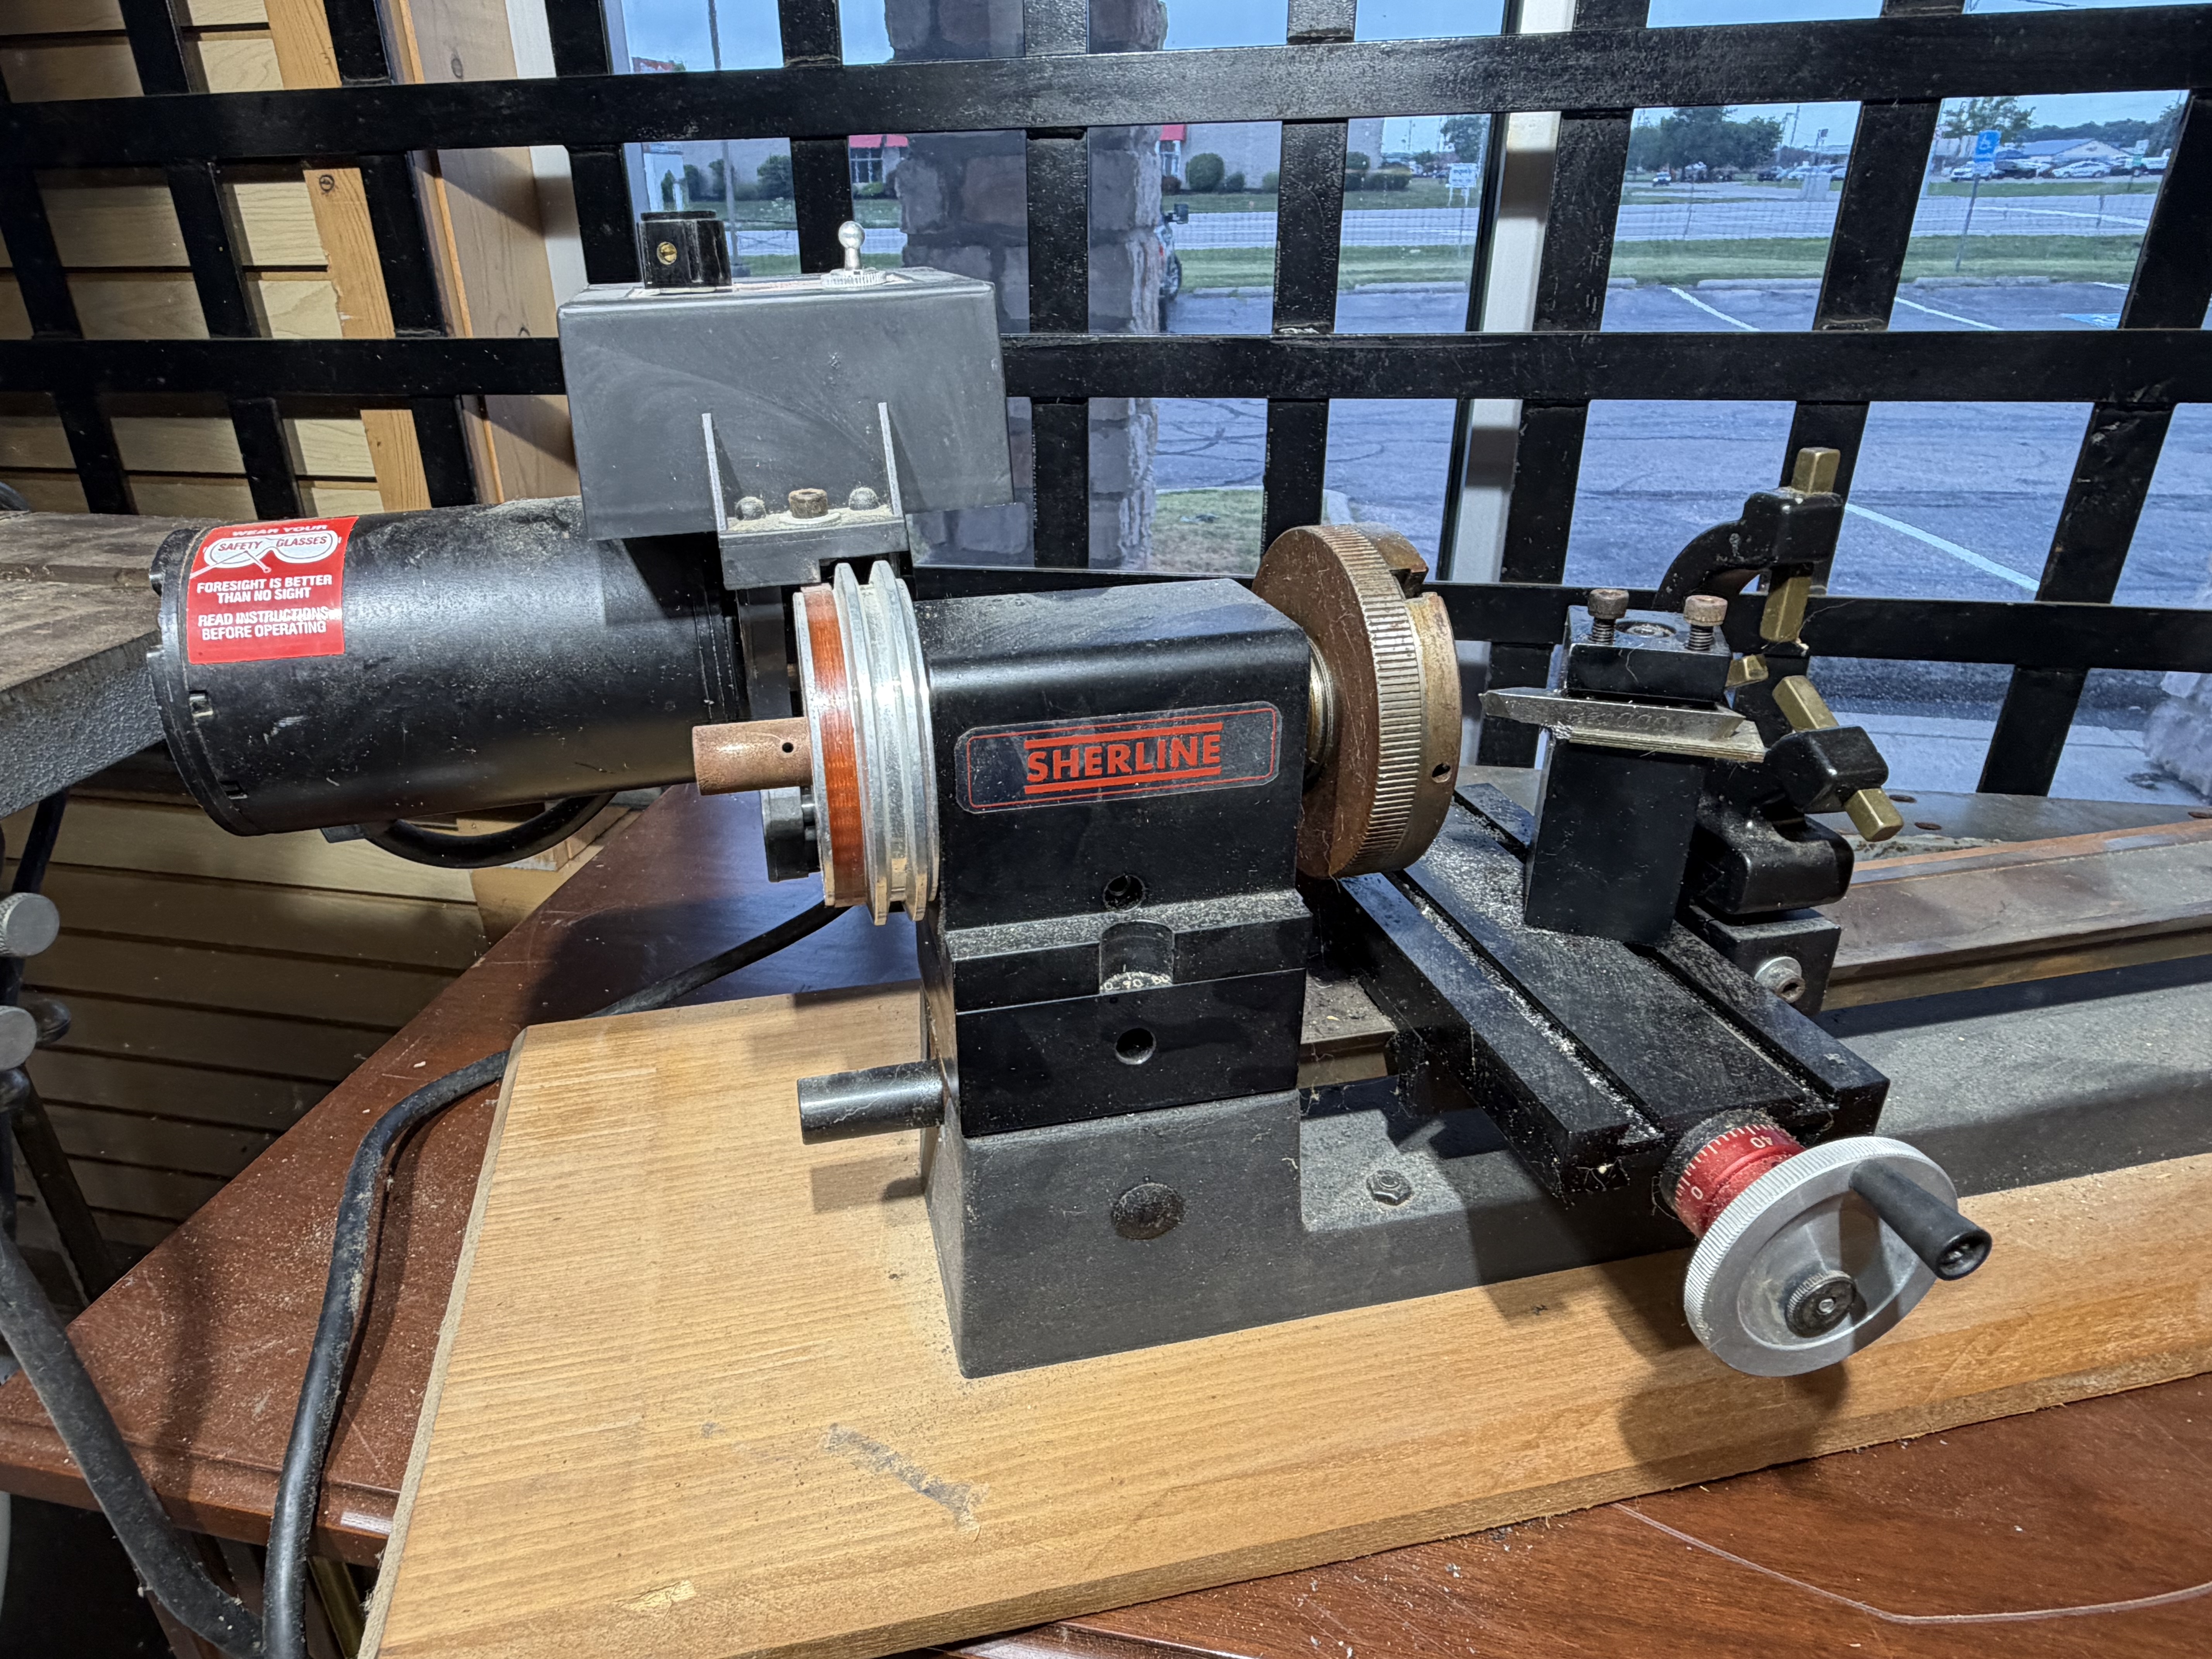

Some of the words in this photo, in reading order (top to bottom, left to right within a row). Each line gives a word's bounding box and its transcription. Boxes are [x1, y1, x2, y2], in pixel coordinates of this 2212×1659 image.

[218, 541, 263, 551] SAFETY
[276, 536, 328, 547] GLASSES
[197, 579, 267, 593] FORESIGHT
[269, 578, 282, 589] IS
[285, 574, 332, 587] BETTER
[217, 591, 251, 604] THAN
[254, 590, 272, 601] NO
[274, 587, 312, 600] SIGHT
[198, 613, 233, 627] READ
[235, 606, 330, 624] INSTRUCTIONS
[202, 625, 252, 641] BEFORE
[254, 621, 326, 637] OPERATING
[1026, 735, 1221, 783] SHERLINE
[1750, 1135, 1774, 1149] 40
[1691, 1185, 1704, 1200] 0
